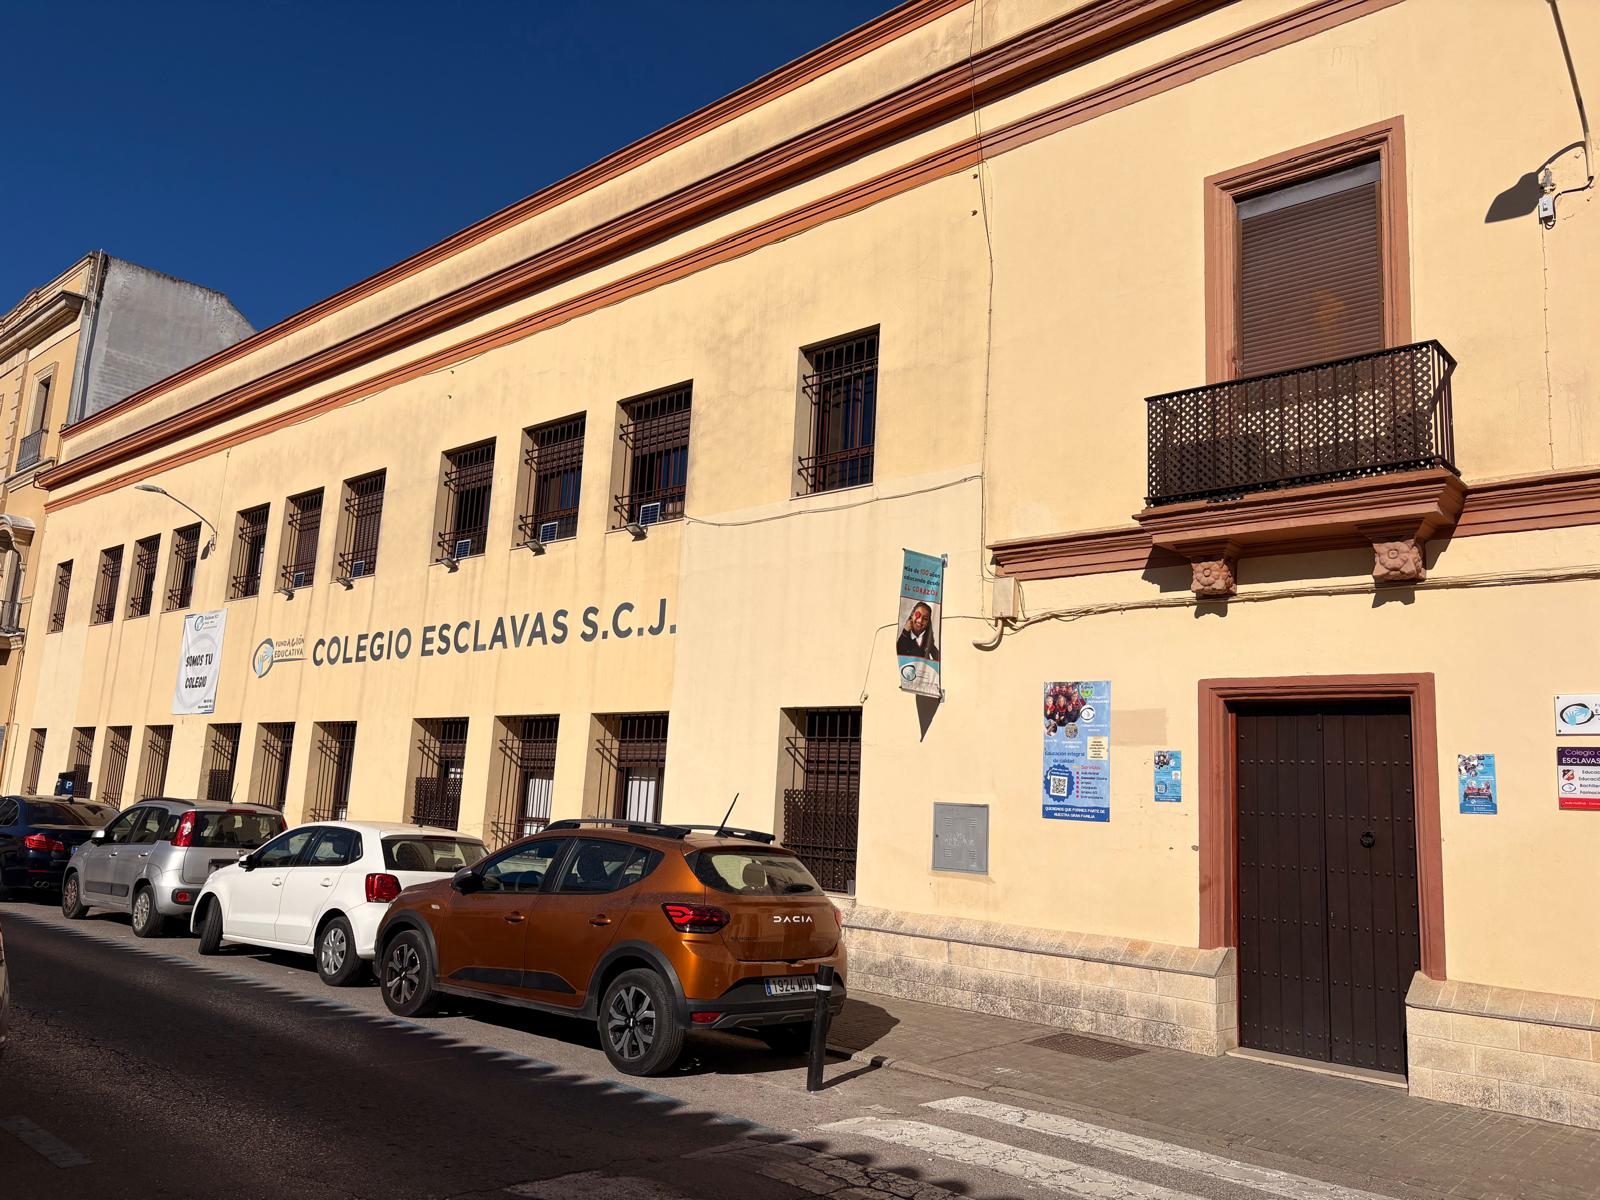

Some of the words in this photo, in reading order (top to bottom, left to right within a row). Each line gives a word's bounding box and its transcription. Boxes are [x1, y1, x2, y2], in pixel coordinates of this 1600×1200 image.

[904, 583, 911, 592] EL
[912, 585, 939, 598] CORAZÓN
[312, 627, 412, 667] COLEGIO
[420, 609, 569, 657] ESCLAVAS
[581, 598, 677, 641] S.C.J.
[185, 654, 204, 667] SOMOS
[205, 653, 214, 665] TU
[274, 649, 304, 659] EDUCATIVA
[184, 676, 208, 689] COLEGIO
[1564, 749, 1596, 757] Colegio
[65, 780, 73, 789] P
[773, 915, 813, 923] DACIA
[773, 978, 795, 993] 1924
